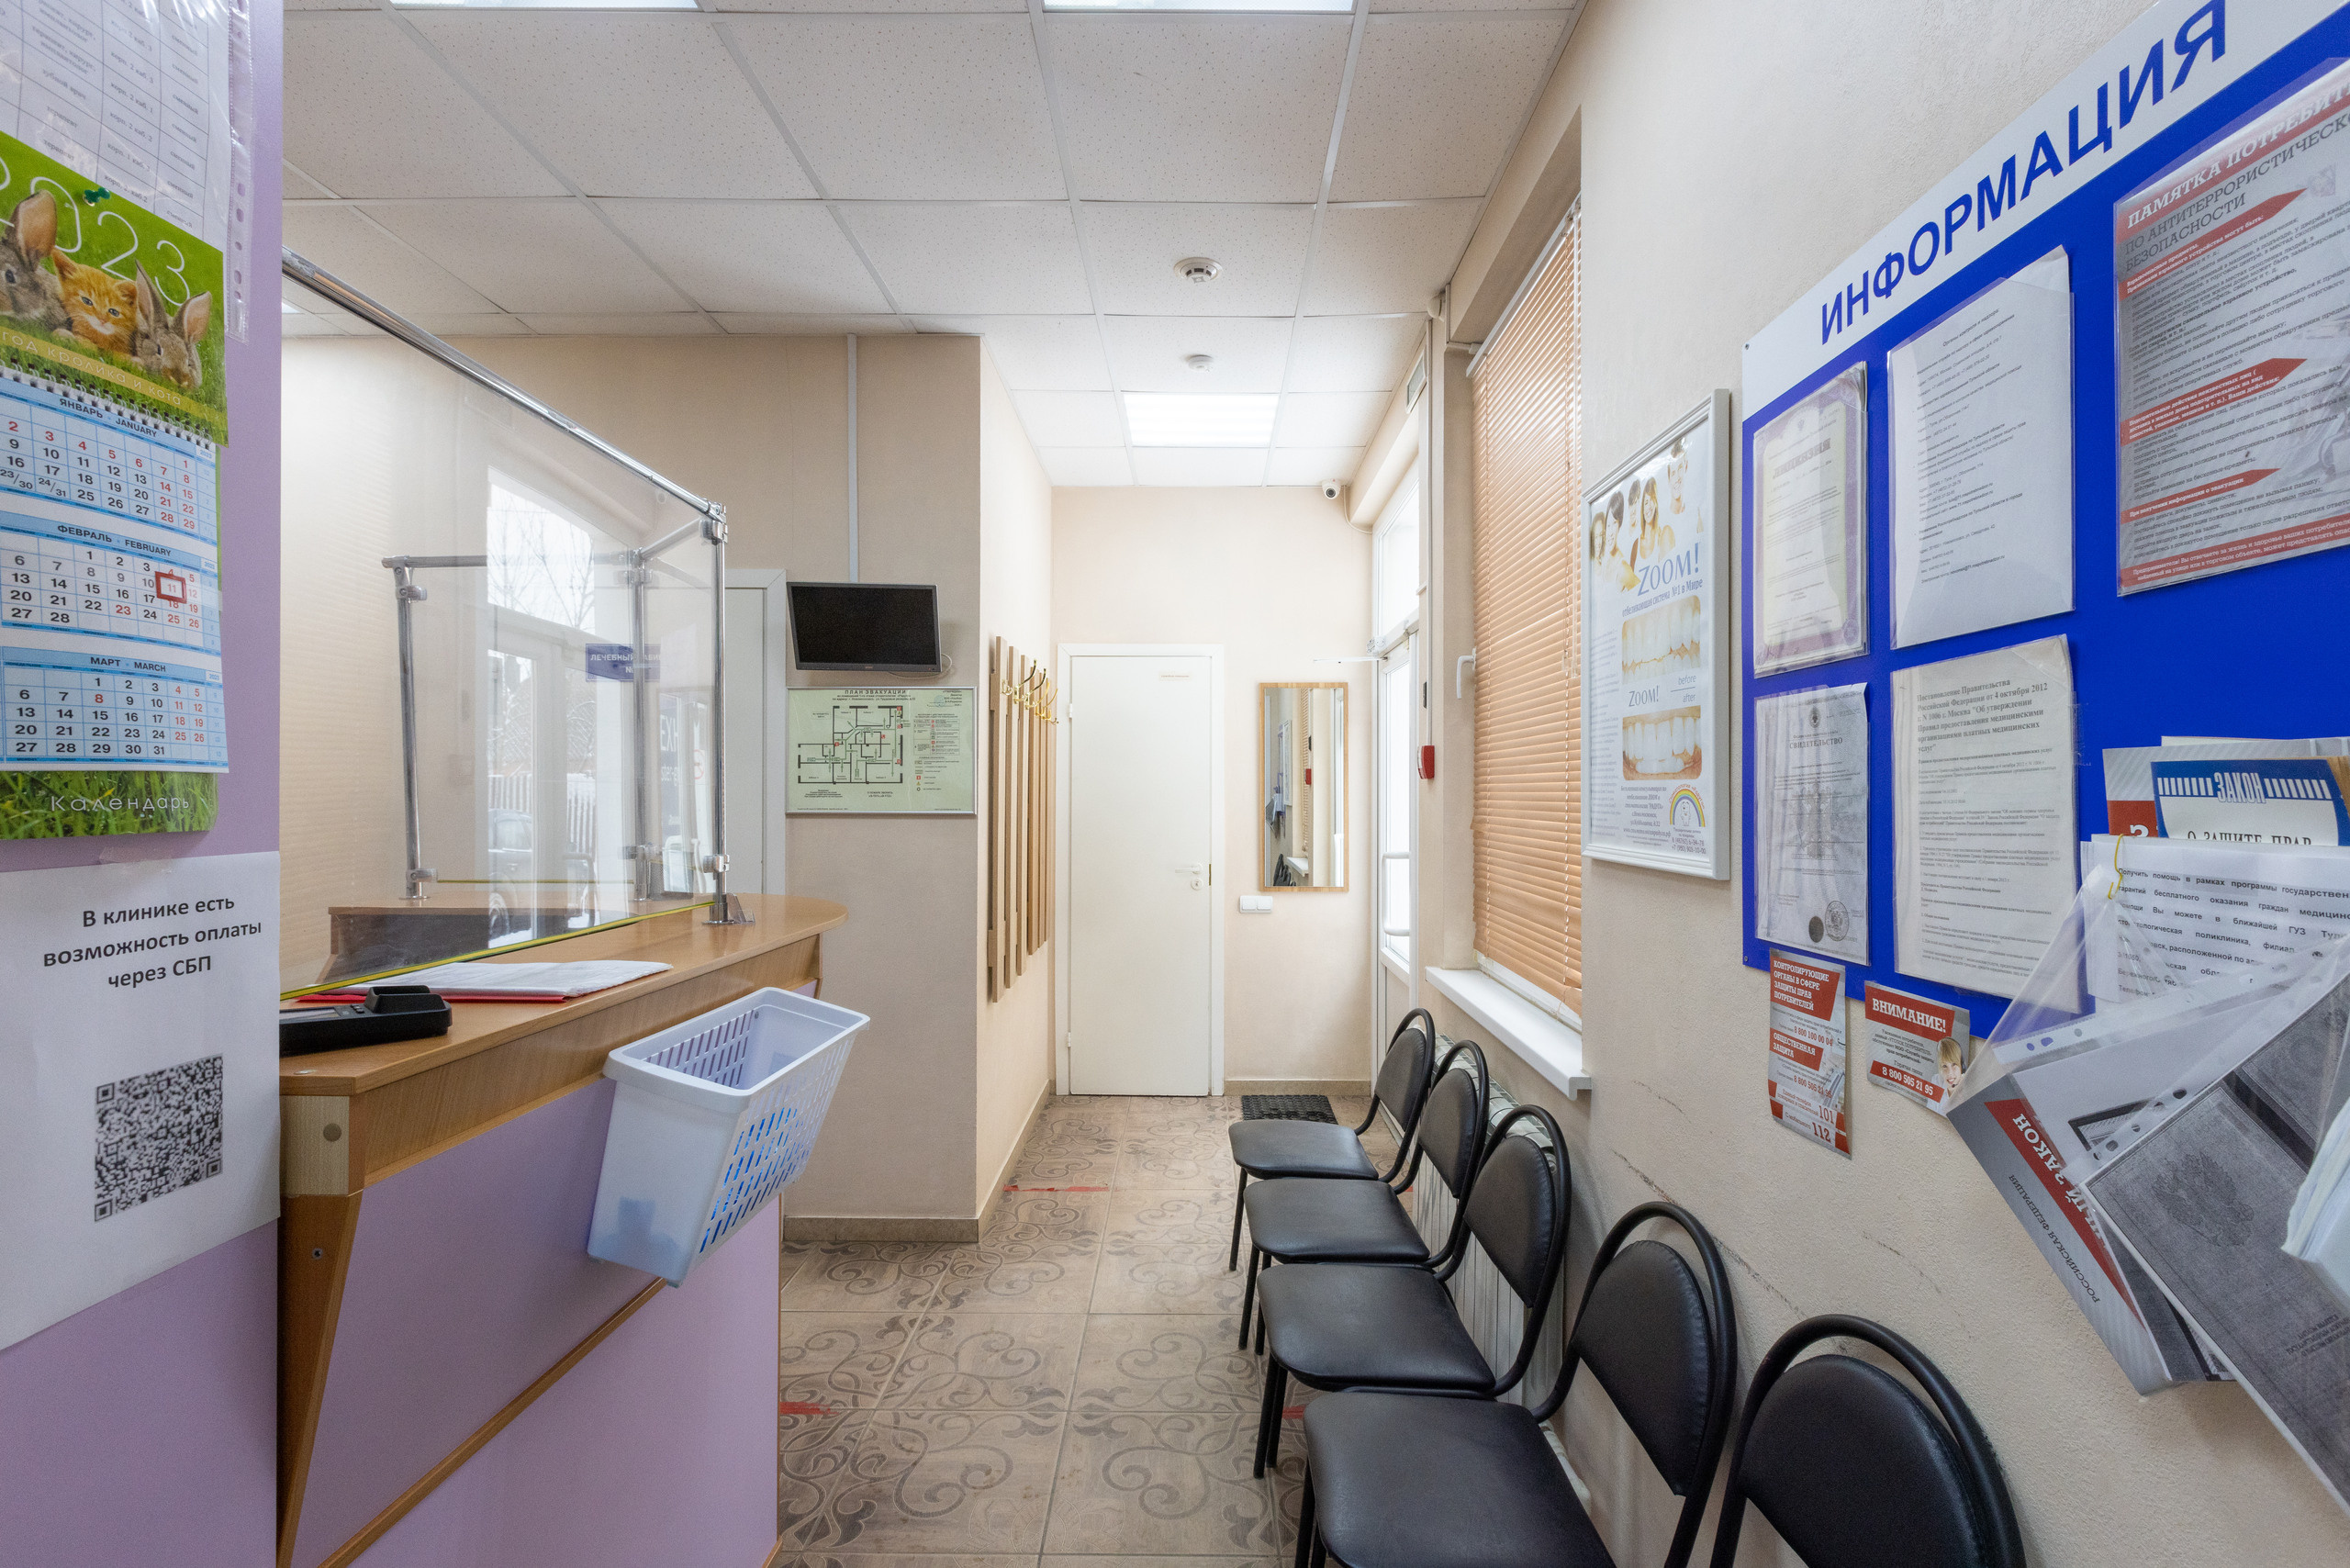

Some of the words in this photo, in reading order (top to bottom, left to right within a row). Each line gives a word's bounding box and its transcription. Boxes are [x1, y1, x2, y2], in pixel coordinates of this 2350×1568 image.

[1820, 0, 2226, 345] ИНФОРМАЦИЯ
[2127, 162, 2222, 229] ПАМЯТКА
[2125, 192, 2247, 272] БЕЗОПАСНОСТИ
[2125, 235, 2144, 255] ПО
[3, 331, 39, 353] год
[48, 347, 126, 383] кролика
[134, 380, 141, 390] и
[149, 386, 181, 406] кота
[59, 398, 104, 419] ЯНВАРЬ
[115, 418, 158, 438] JANUARY
[57, 525, 112, 543] ФЕВРАЛЬ
[125, 539, 172, 556] FEBRUARY
[1637, 541, 1702, 597] ZOOM!
[1685, 578, 1704, 591] Мире
[90, 656, 121, 667] МАРТ
[134, 661, 166, 672] MARCH
[125, 680, 132, 689] 2
[152, 683, 159, 691] 3
[175, 686, 181, 694] 4
[195, 689, 200, 697] 5
[1677, 674, 1696, 686] before
[1917, 689, 1961, 702] Постановление
[1961, 679, 2010, 694] Правительства
[19, 690, 29, 699] 6
[59, 692, 68, 700] 7
[95, 694, 103, 703] 8
[127, 696, 134, 705] 9
[151, 699, 162, 707] 10
[175, 701, 184, 710] 11
[194, 704, 203, 712] 12
[1628, 685, 1659, 707] ZOOM!
[1682, 693, 1696, 703] after
[1917, 701, 1950, 712] Российской
[1951, 696, 1985, 707] Федерации
[1999, 687, 2030, 698] октября
[2031, 683, 2048, 692] 2012
[17, 707, 36, 717] 13
[57, 710, 73, 718] 14
[93, 711, 108, 720] 15
[125, 712, 138, 722] 16
[152, 715, 163, 723] 17
[175, 717, 185, 725] 18
[195, 719, 203, 727] 19
[1941, 718, 1989, 730] предоставления
[1990, 709, 2043, 722] медицинскими
[1948, 709, 1971, 718] Москва
[1986, 700, 2032, 714] утверждении
[15, 725, 37, 734] 20
[56, 726, 73, 735] 21
[92, 728, 109, 736] 22
[125, 729, 140, 738] 23
[152, 731, 165, 739] 24
[195, 734, 204, 742] 26
[1963, 726, 1991, 737] платных
[1992, 722, 2040, 733] медицинских
[16, 743, 38, 752] 27
[56, 744, 76, 752] 28
[93, 745, 111, 753] 29
[125, 745, 141, 754] 30
[153, 746, 165, 755] 31
[2214, 772, 2266, 804] ЗАКОН
[50, 795, 189, 812] Календарь
[2119, 868, 2148, 878] Получить
[2153, 873, 2181, 881] помощь
[2196, 878, 2225, 887] рамках
[2231, 881, 2277, 893] программы
[83, 910, 96, 927] В
[103, 901, 190, 925] клинике
[195, 897, 235, 914] есть
[2154, 889, 2199, 902] бесплатного
[2210, 898, 2249, 907] оказания
[2258, 902, 2289, 913] граждан
[2174, 911, 2203, 920] можете
[2232, 918, 2277, 931] ближайшей
[2289, 925, 2306, 935] ГУЗ
[43, 932, 189, 968] возможность
[195, 922, 263, 944] оплаты
[2196, 931, 2251, 946] поликлиника,
[108, 967, 167, 989] через
[173, 955, 212, 977] СБП
[1774, 960, 1830, 982] КОНТРОЛИРУЮЩИЕ
[1774, 971, 1796, 984] ОРГАНЫ
[1800, 979, 1820, 991] СФЕРЕ
[1774, 980, 1796, 995] ЗАЩИТЫ
[1797, 988, 1812, 999] ПРАВ
[1774, 991, 1814, 1011] ПОТРЕБИТЕЛЕЙ
[1873, 998, 1946, 1034] ВНИМАНИЕ!
[1774, 1032, 1816, 1056] ОБЩЕСТВЕННАЯ
[1797, 1027, 1807, 1037] 800
[1808, 1031, 1818, 1041] 100
[1774, 1043, 1794, 1058] ЗАЩИТА
[1882, 1067, 1887, 1076] 8
[1889, 1069, 1902, 1081] 800
[1904, 1074, 1915, 1089] 505
[1916, 1080, 1923, 1091] 21
[1924, 1083, 1933, 1096] 95
[1818, 1105, 1834, 1125] 101
[1812, 1122, 1832, 1144] 112
[2012, 1113, 2065, 1186] ЗАКОН
[2009, 1174, 2051, 1232] ФЕДЕРАЦИЯ
[2048, 1231, 2100, 1304] РОССИЙСКАЯ
